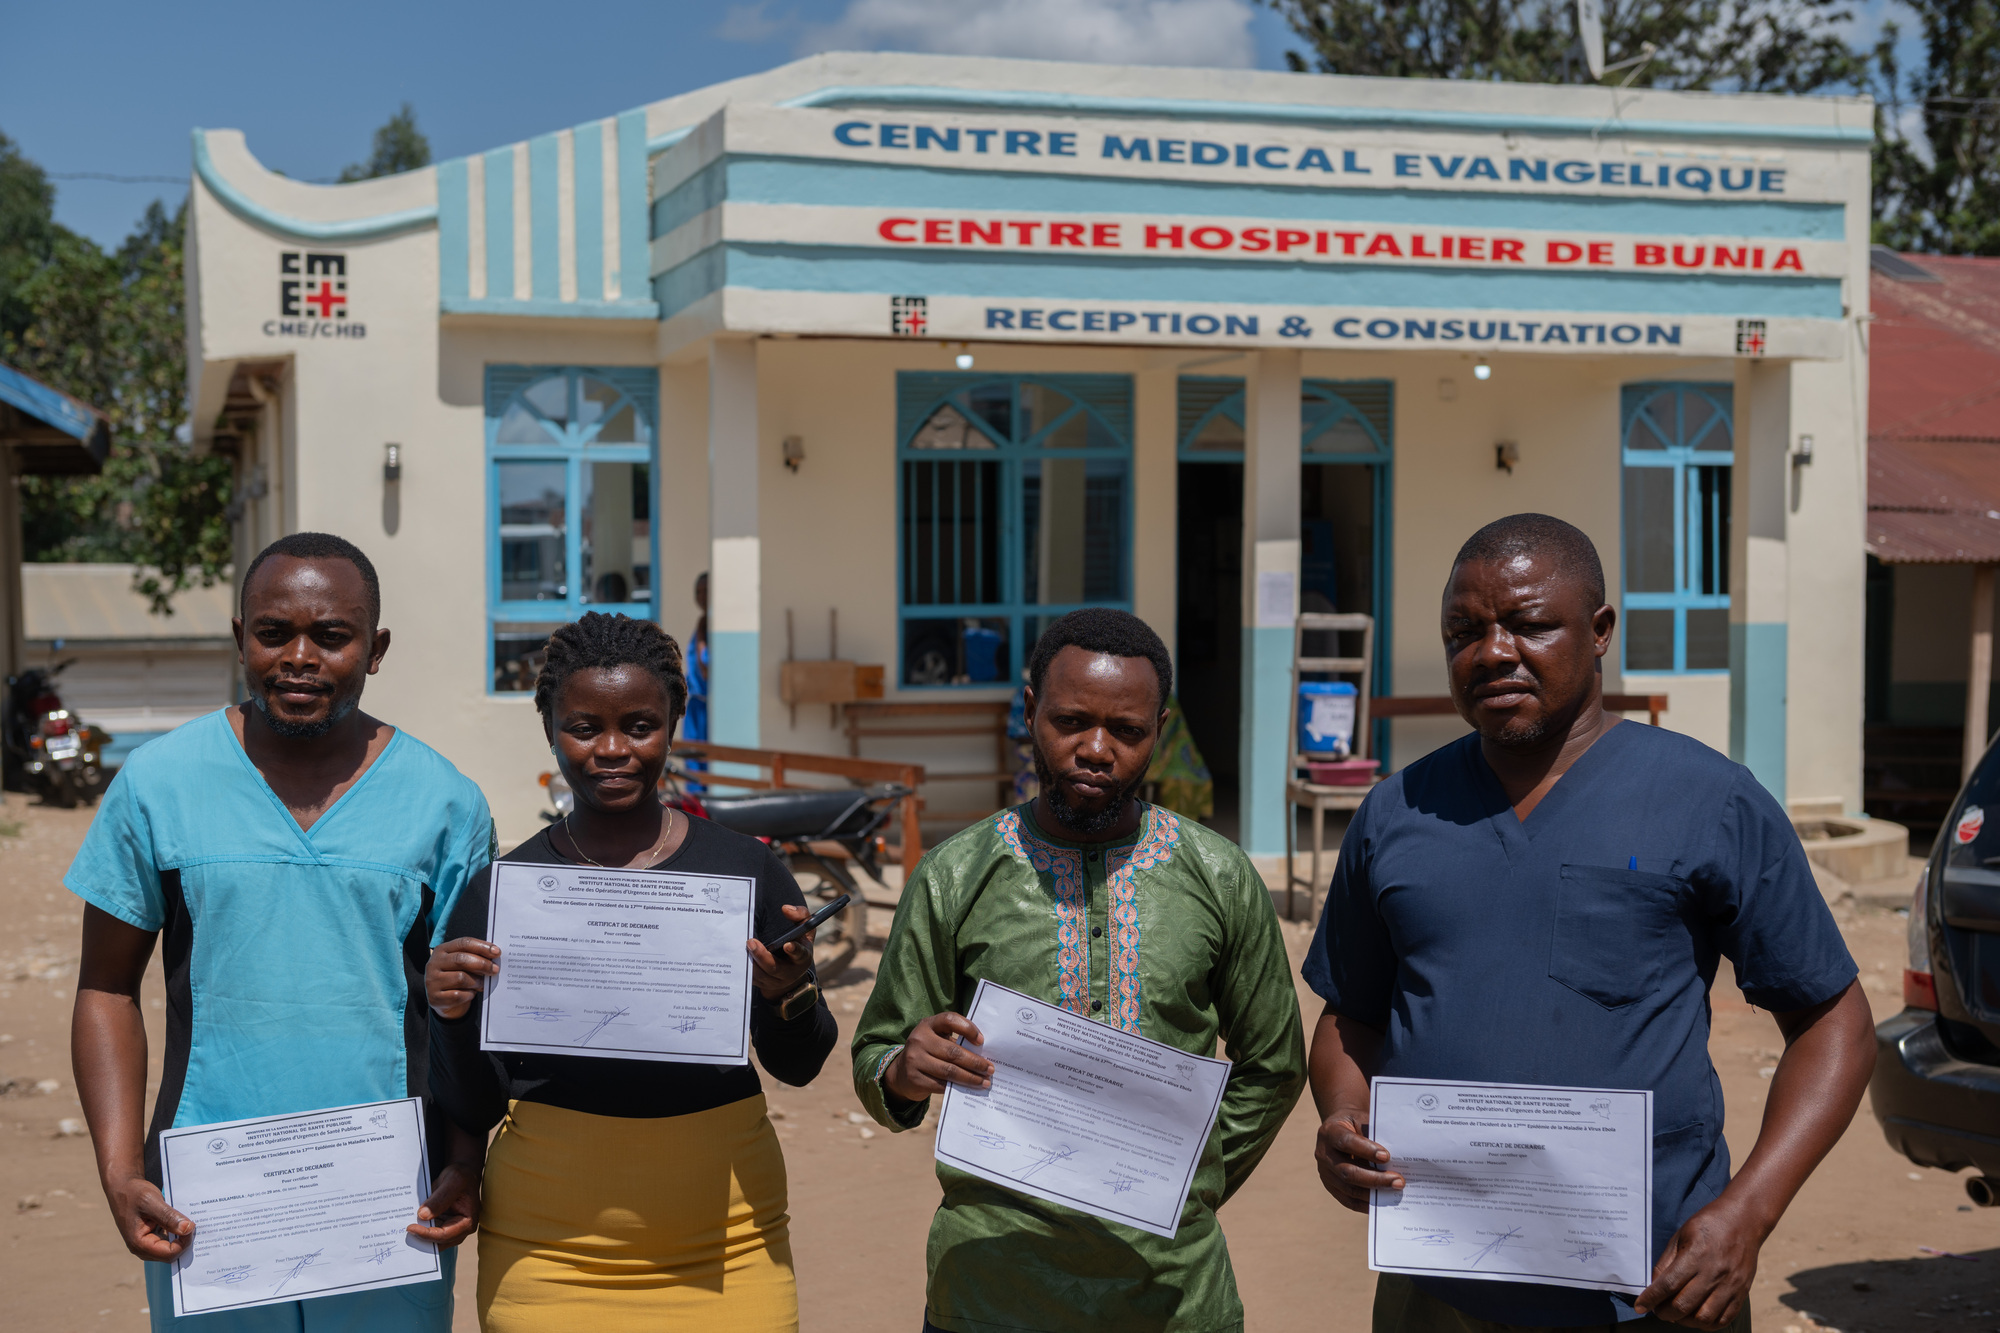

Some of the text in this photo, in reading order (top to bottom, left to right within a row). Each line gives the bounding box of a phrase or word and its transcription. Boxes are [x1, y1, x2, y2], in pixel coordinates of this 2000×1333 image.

[834, 121, 1786, 194] CENTRE MEDICAL EVANGELIQUE
[878, 218, 1805, 271] CENTRE HOSPITALIER DE BUNIA
[262, 320, 366, 339] CME/CHB
[985, 307, 1683, 346] RECEPTION & CONSULTATION
[1044, 1025, 1061, 1034] Centre
[1070, 1034, 1097, 1047] Opérations
[1097, 1043, 1124, 1056] d'Urgences
[1131, 1054, 1145, 1063] Santé
[1145, 1059, 1167, 1070] Publique
[264, 1137, 292, 1145] Opérations
[263, 1168, 295, 1178] CERTIFICAT
[304, 1162, 334, 1171] DECHARGE
